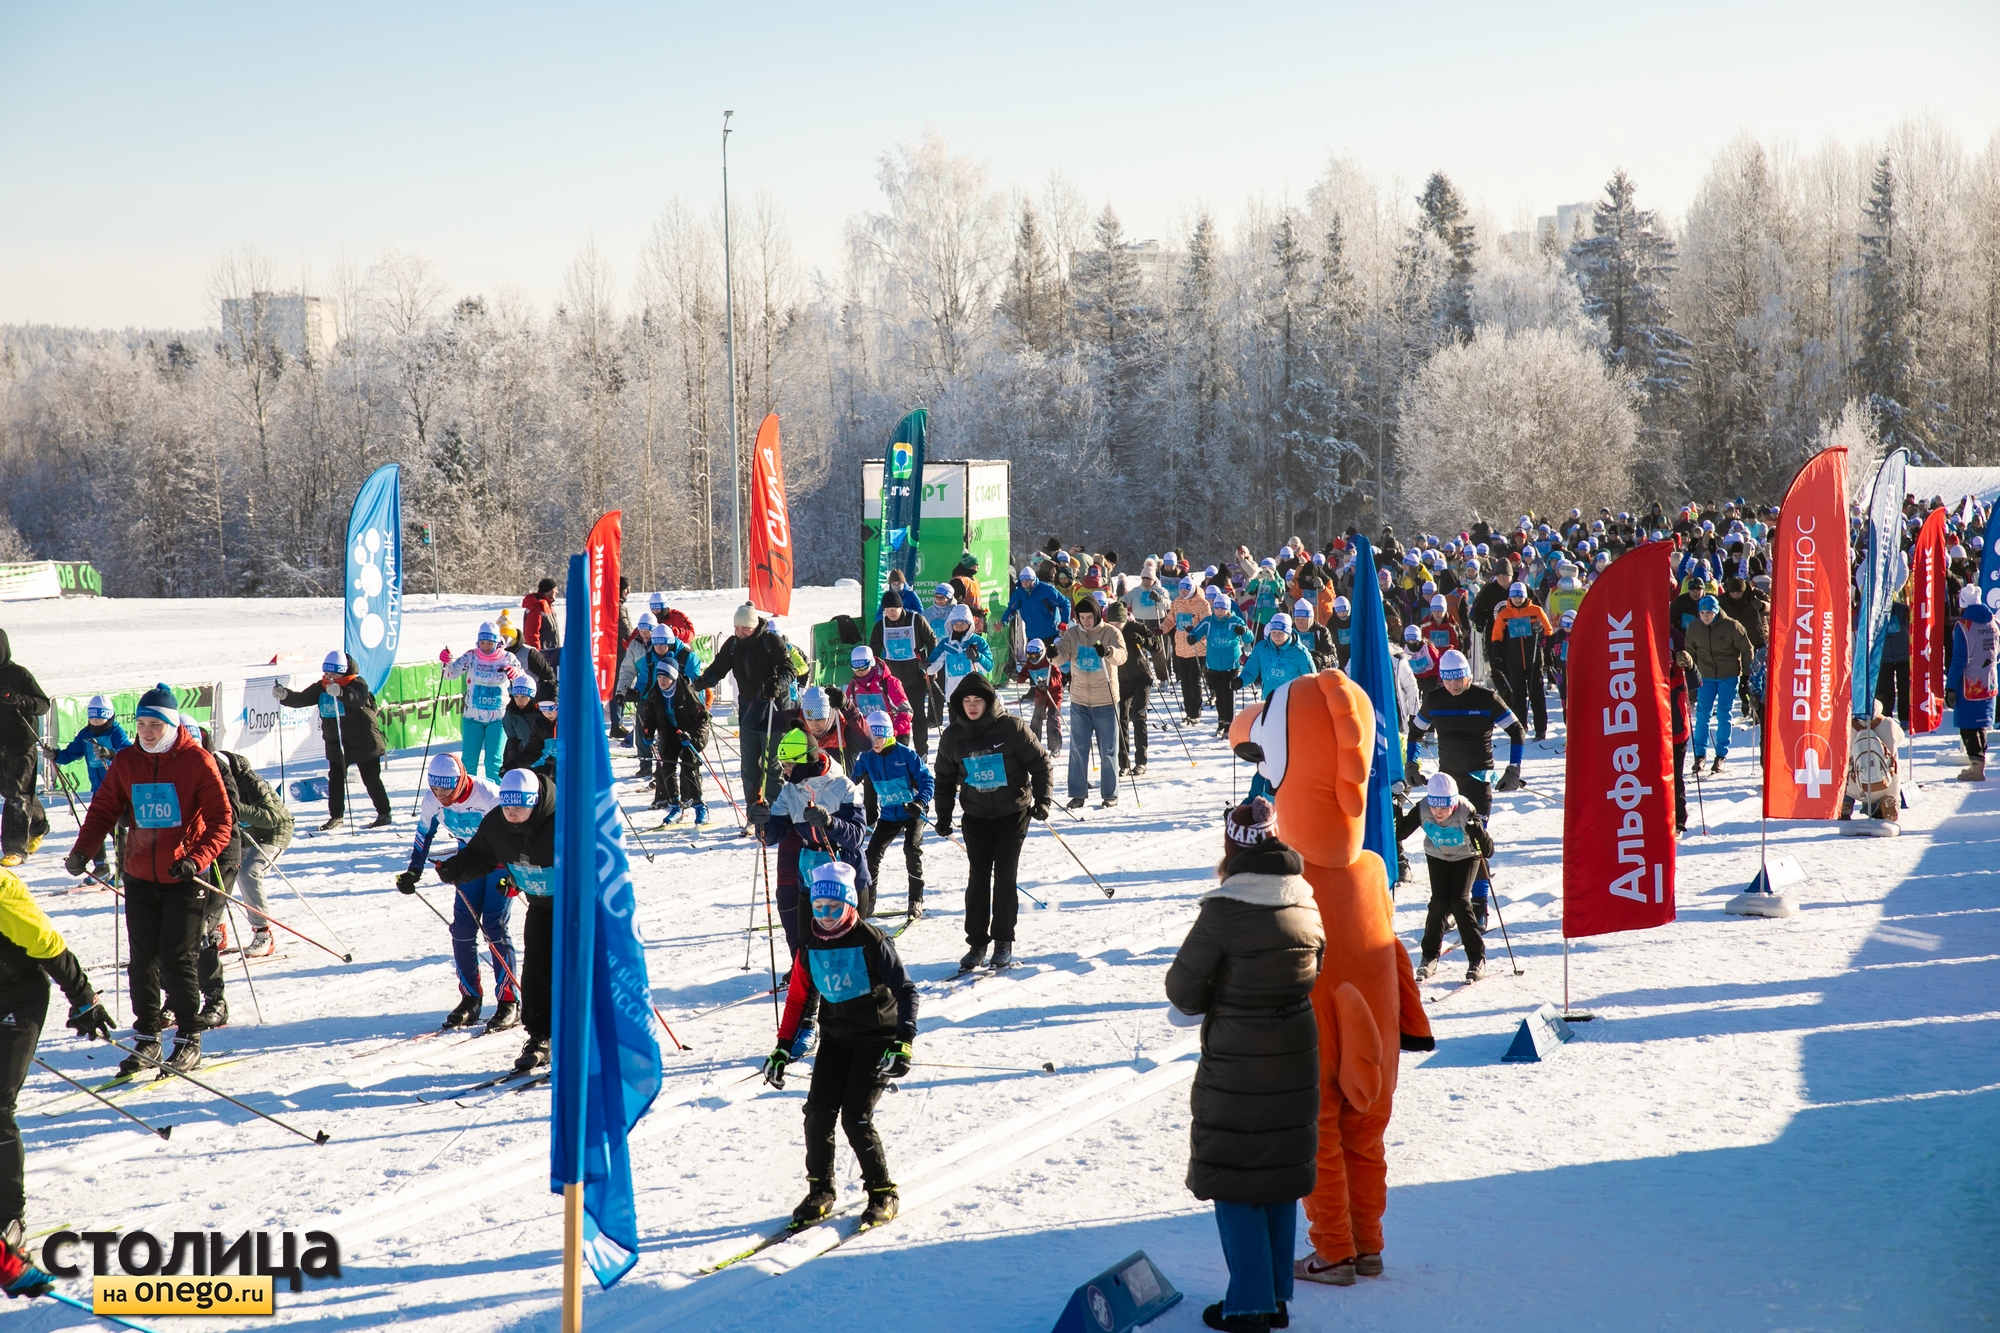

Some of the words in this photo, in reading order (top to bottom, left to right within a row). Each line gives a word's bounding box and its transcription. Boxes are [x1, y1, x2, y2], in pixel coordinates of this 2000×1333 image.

[975, 483, 1002, 502] СТАРТ
[591, 544, 605, 608] Банк
[384, 529, 400, 651] СИТИЛИНК
[592, 611, 605, 677] льфа
[1270, 668, 1285, 678] 929
[1603, 609, 1639, 736] Банк
[1817, 611, 1834, 722] Стоматология
[478, 697, 497, 706] 1092
[973, 769, 995, 782] 559
[139, 803, 172, 819] 1760
[1606, 744, 1652, 904] Альфа
[525, 880, 547, 890] 587
[823, 972, 853, 992] 124
